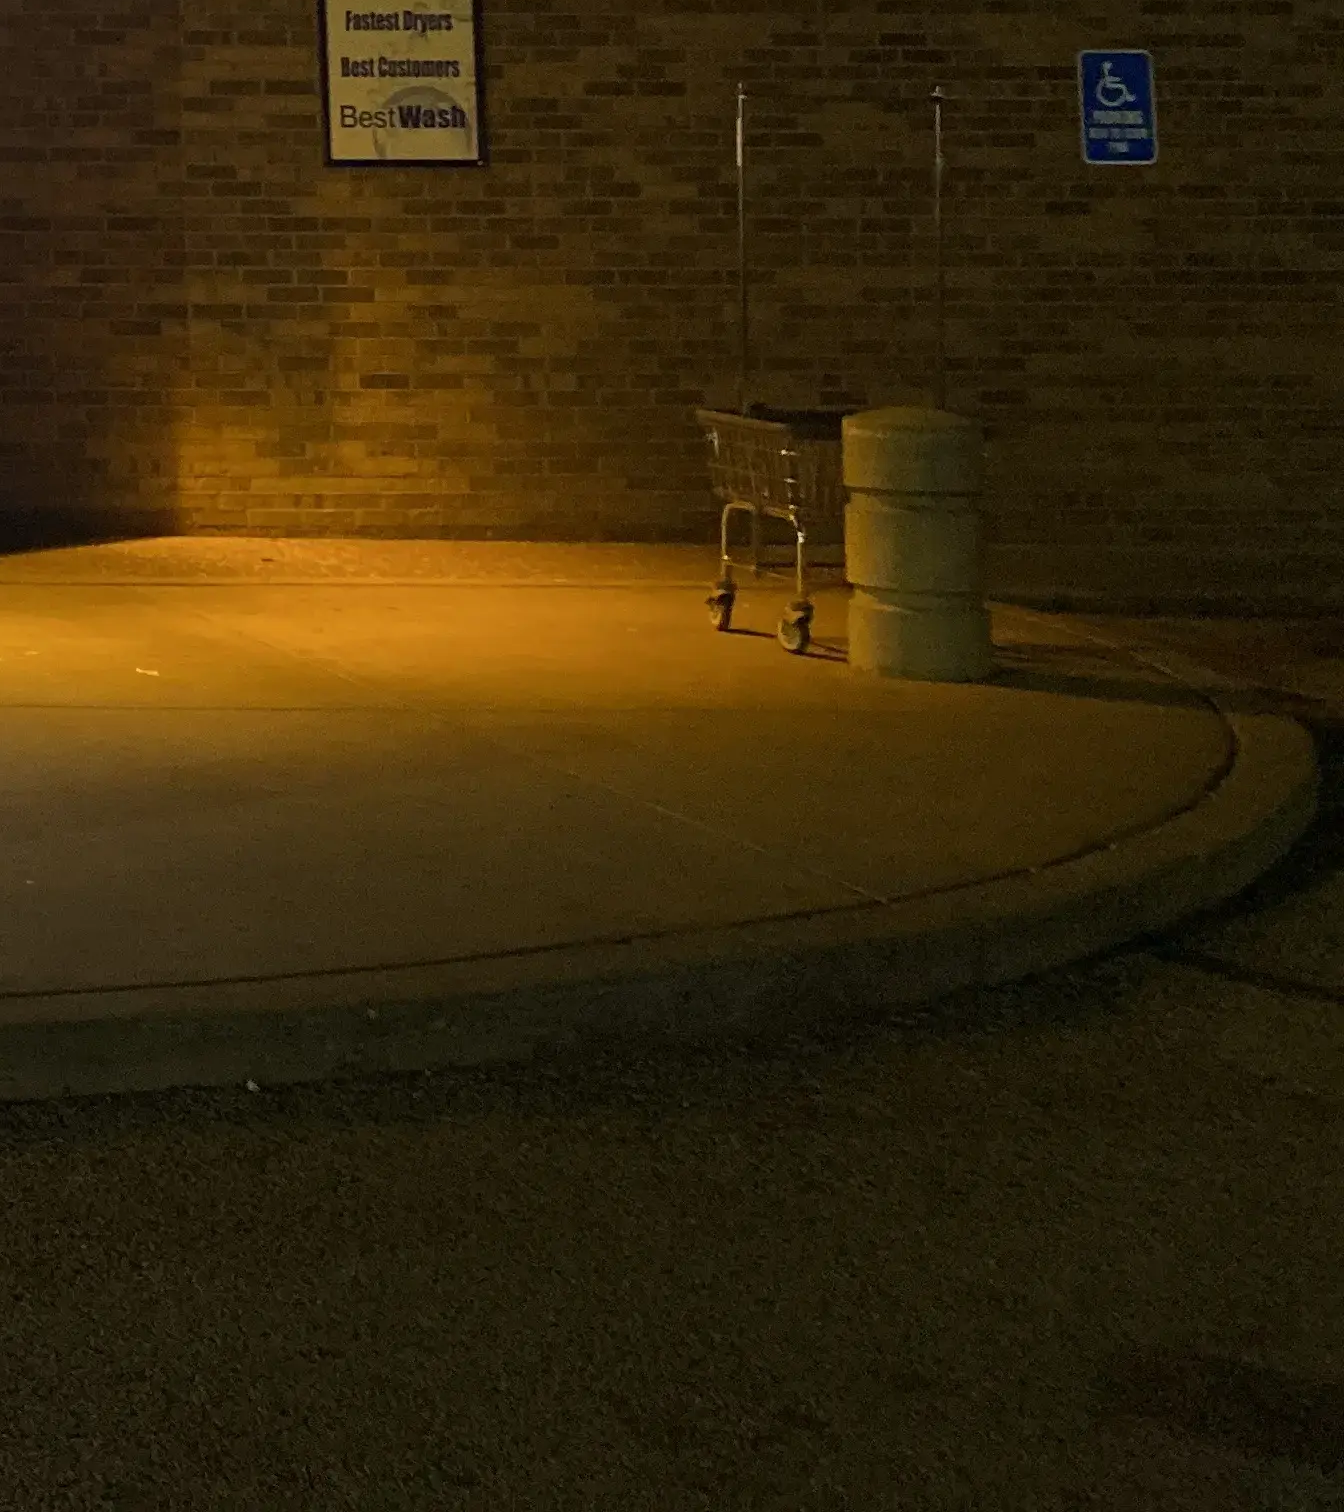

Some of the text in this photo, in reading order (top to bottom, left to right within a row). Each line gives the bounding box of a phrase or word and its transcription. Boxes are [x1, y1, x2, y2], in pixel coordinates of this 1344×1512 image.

[345, 10, 454, 33] Fastest Dryers
[341, 56, 460, 78] Best Customers
